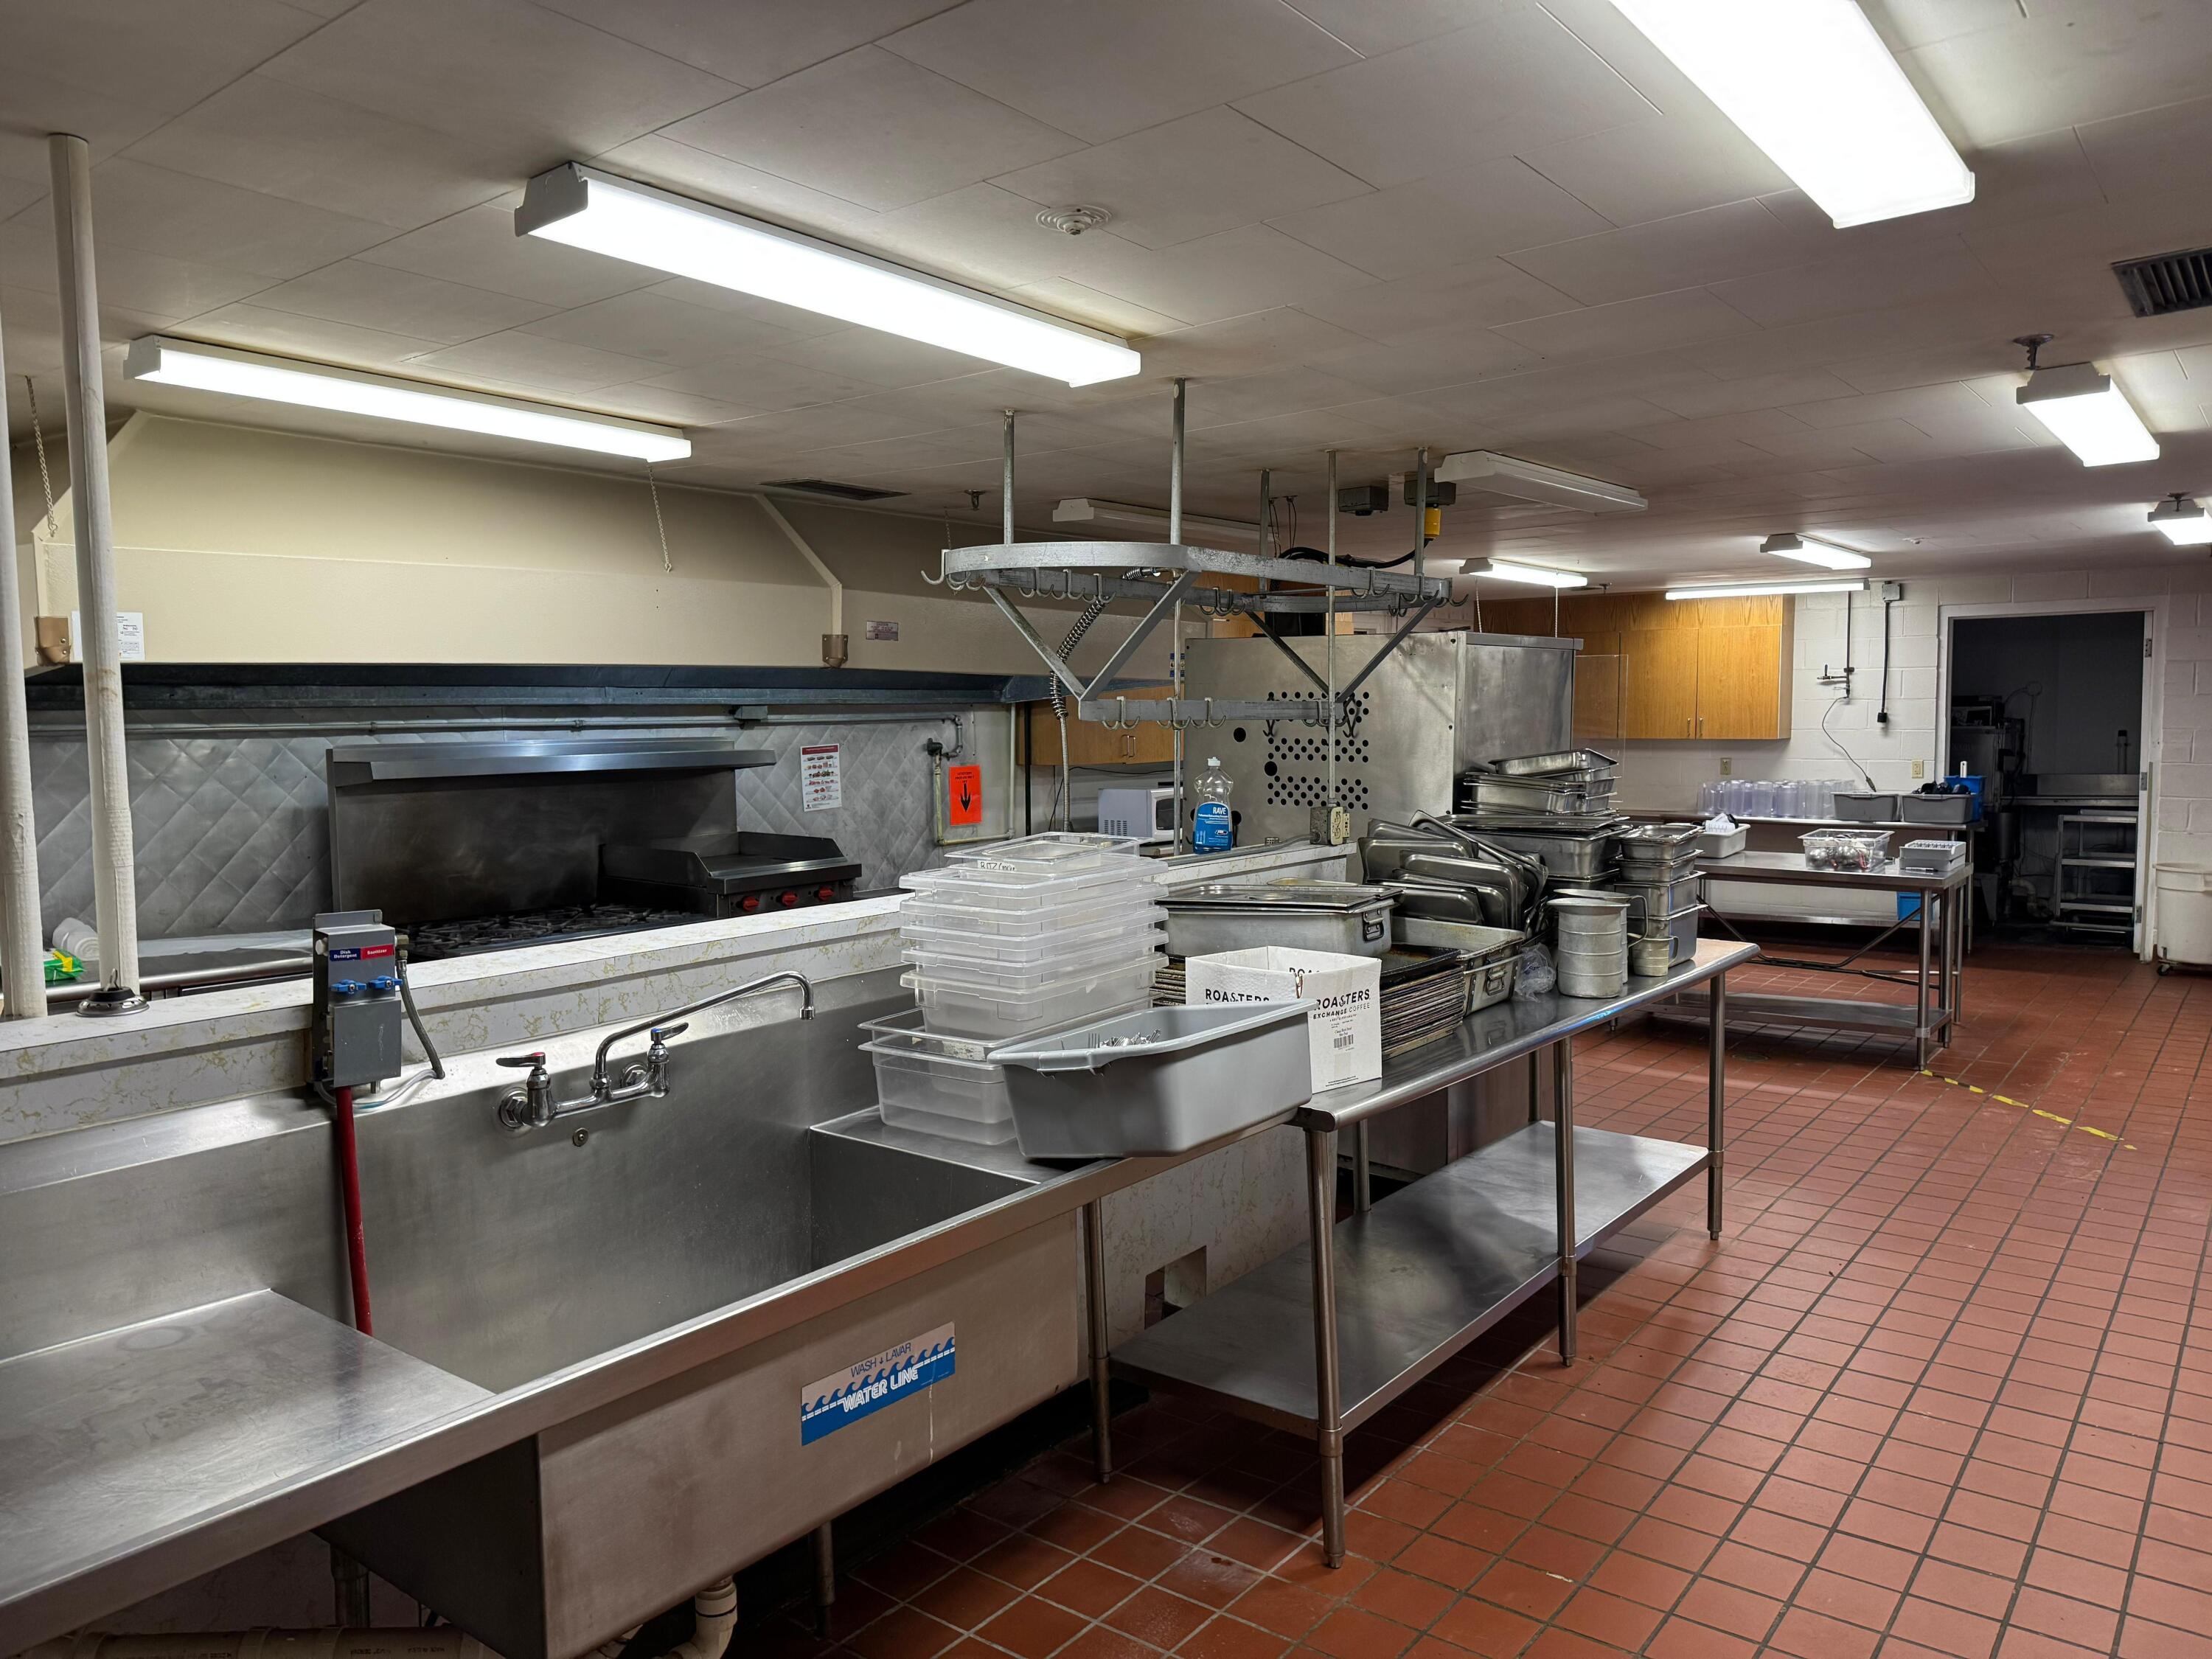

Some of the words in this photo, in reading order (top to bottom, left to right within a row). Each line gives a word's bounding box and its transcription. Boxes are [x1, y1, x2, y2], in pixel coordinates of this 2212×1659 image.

[1212, 807, 1227, 815] RAVE
[1312, 1008, 1347, 1020] EXCHANGE
[1349, 1003, 1370, 1013] COFFEE
[851, 1357, 877, 1377] WASH
[886, 1342, 911, 1362] LAVAR
[838, 1380, 888, 1413] WATER
[890, 1366, 919, 1391] LINE
